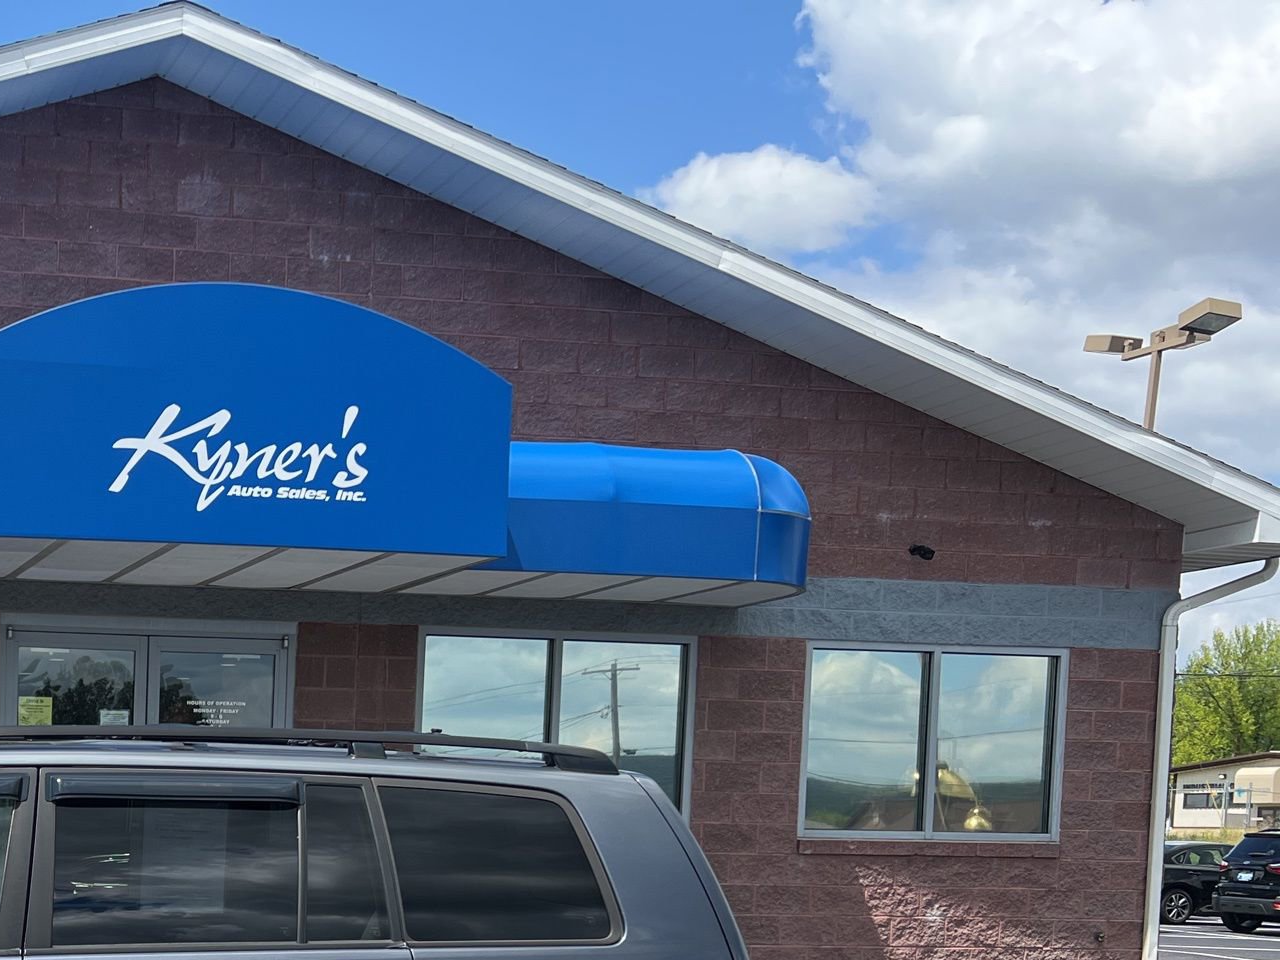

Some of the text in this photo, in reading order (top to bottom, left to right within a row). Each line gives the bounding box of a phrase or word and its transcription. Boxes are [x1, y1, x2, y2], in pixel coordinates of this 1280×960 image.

[108, 403, 368, 512] Kyner's
[227, 485, 367, 502] Auto Sales, Inc.
